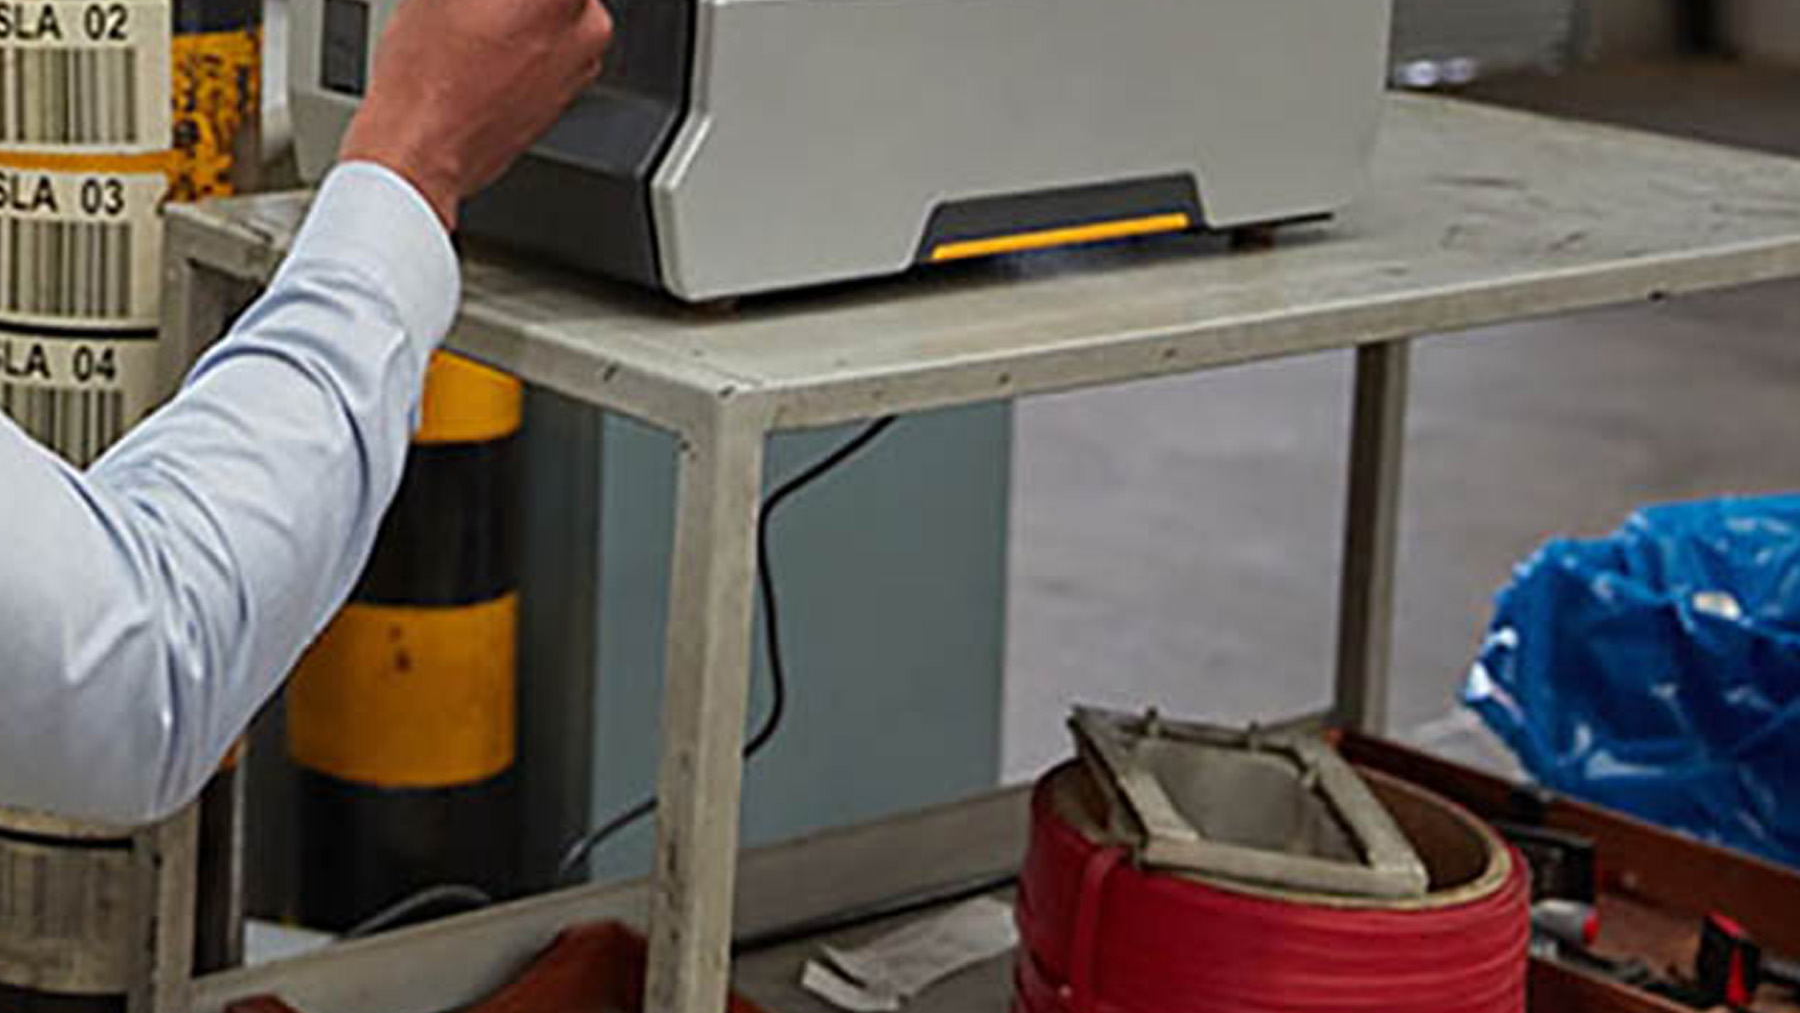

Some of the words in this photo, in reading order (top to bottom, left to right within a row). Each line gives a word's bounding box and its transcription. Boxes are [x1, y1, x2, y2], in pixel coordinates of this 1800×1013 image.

[84, 4, 129, 41] 02
[81, 178, 125, 216] 03
[72, 346, 117, 382] 04
